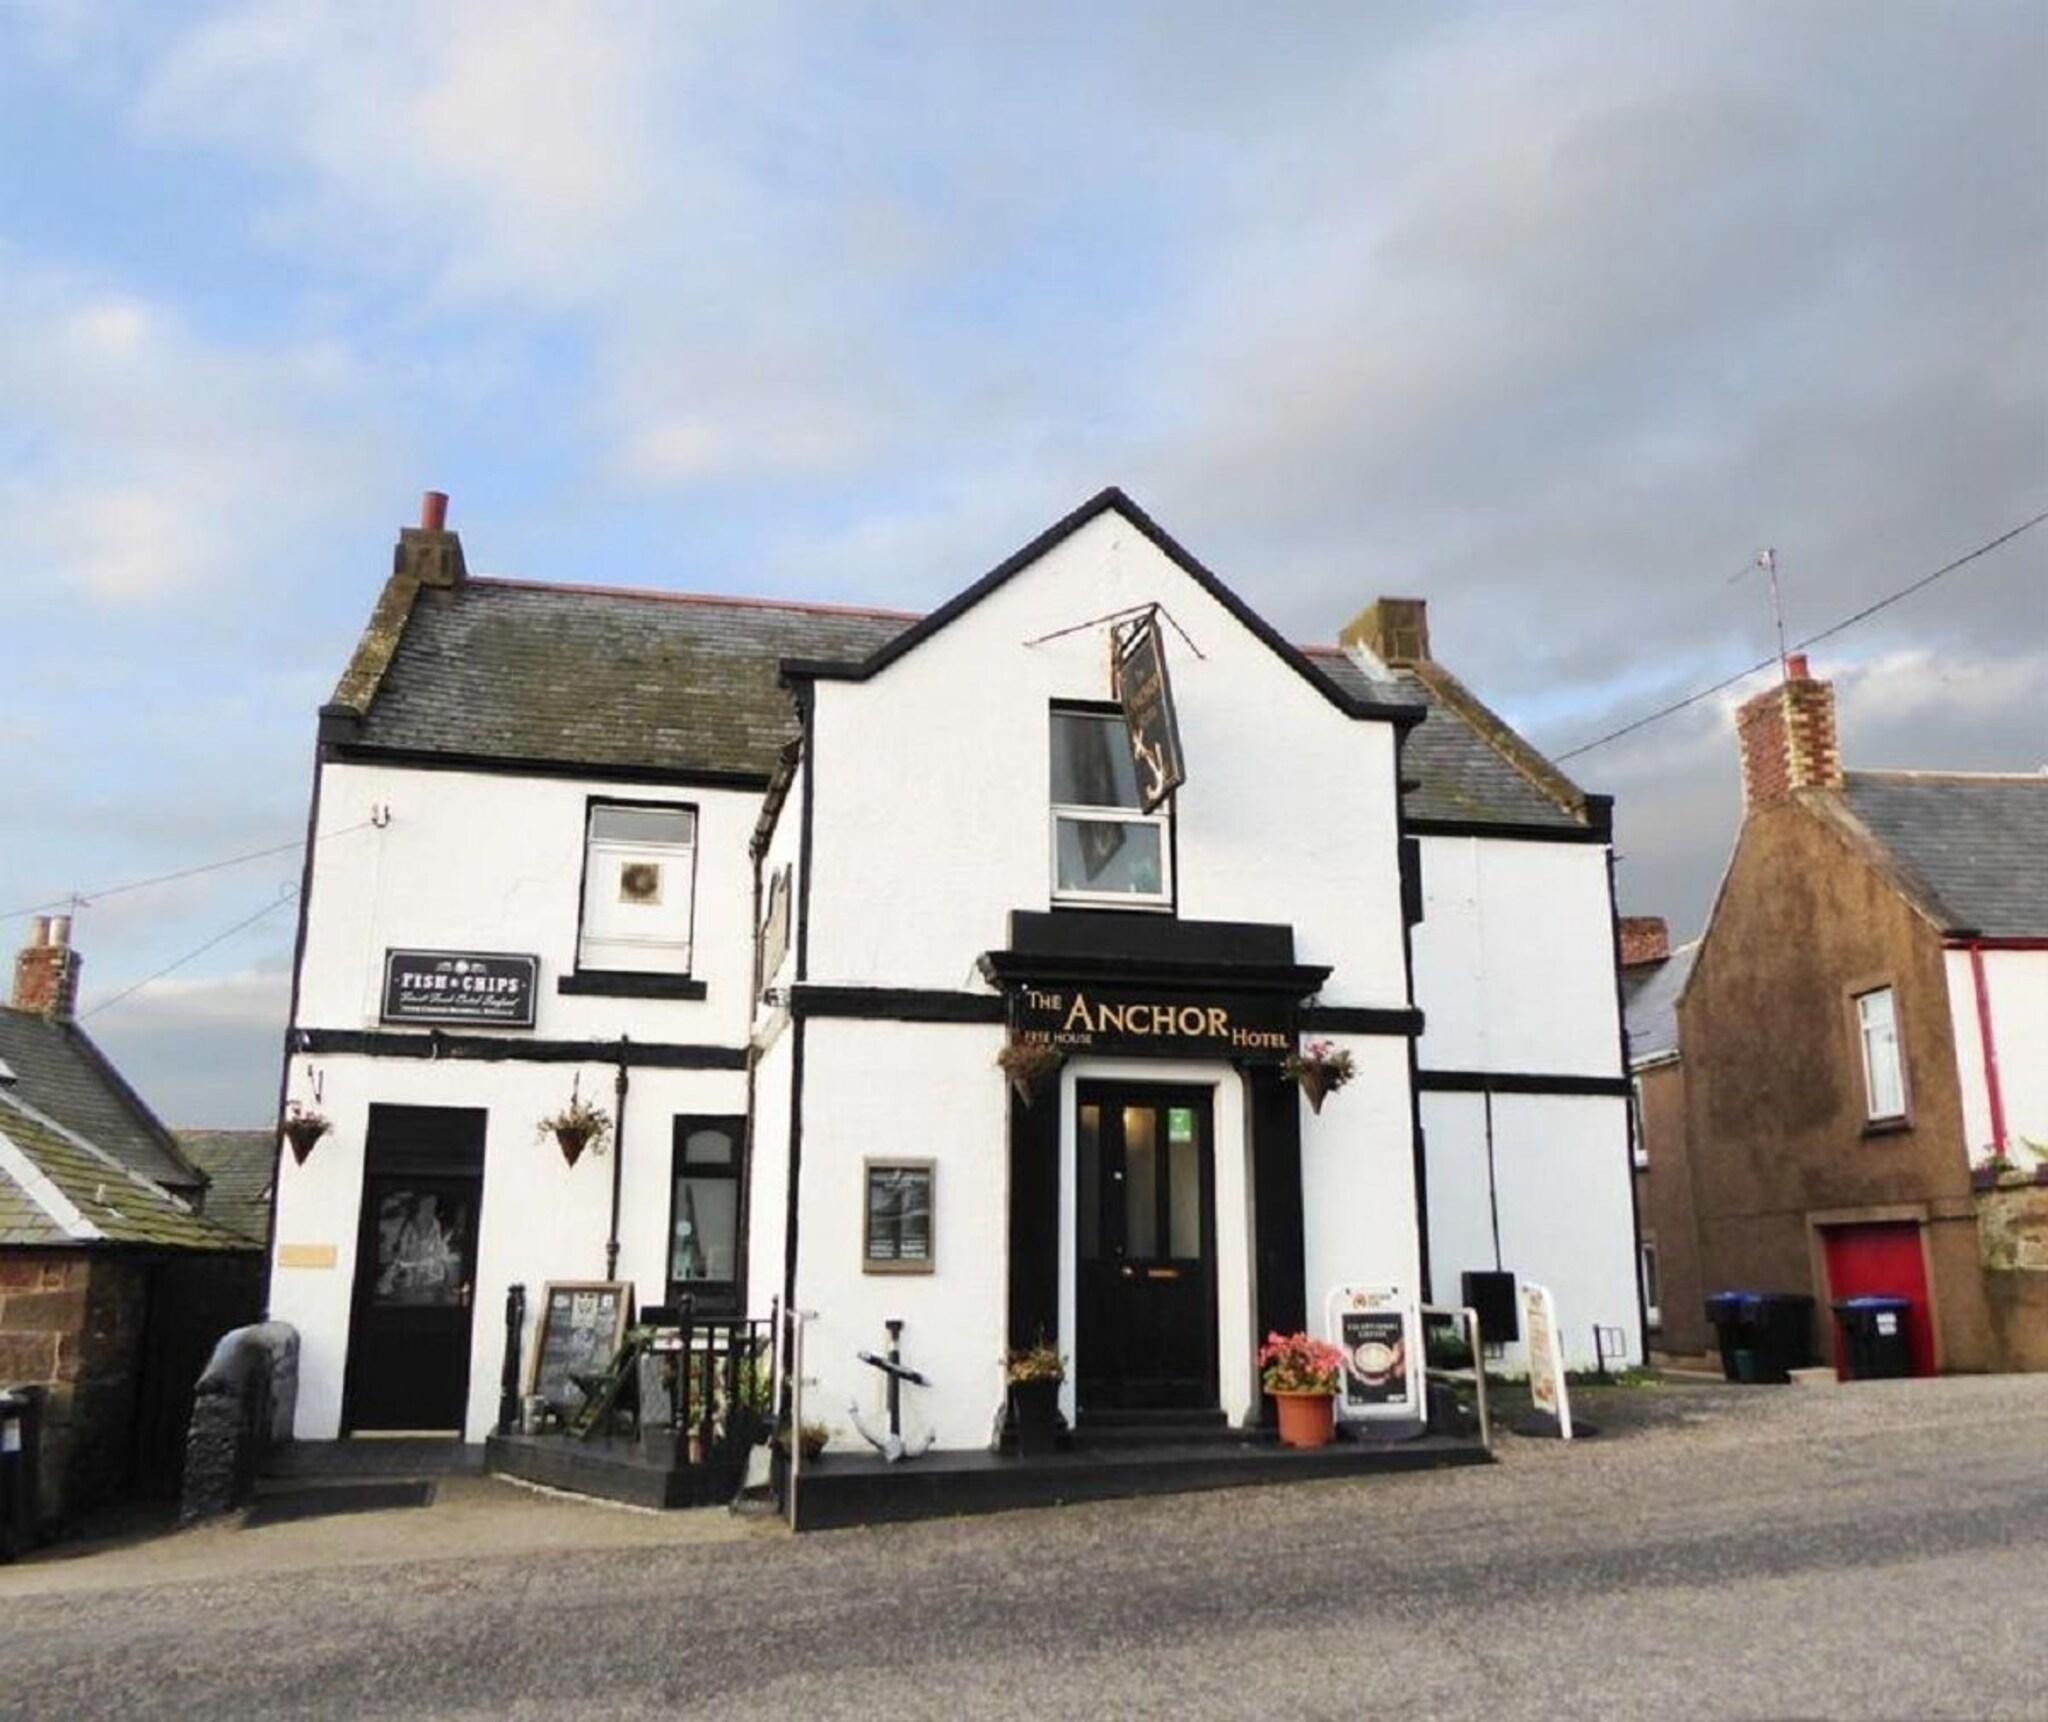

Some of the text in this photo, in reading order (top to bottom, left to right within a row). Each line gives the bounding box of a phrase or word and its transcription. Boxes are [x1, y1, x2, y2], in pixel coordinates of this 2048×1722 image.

[401, 972, 448, 989] FISH
[462, 976, 519, 992] CHIPS
[1026, 990, 1290, 1049] THE ANCHOR HOTEL
[1054, 1031, 1092, 1044] HOUSE
